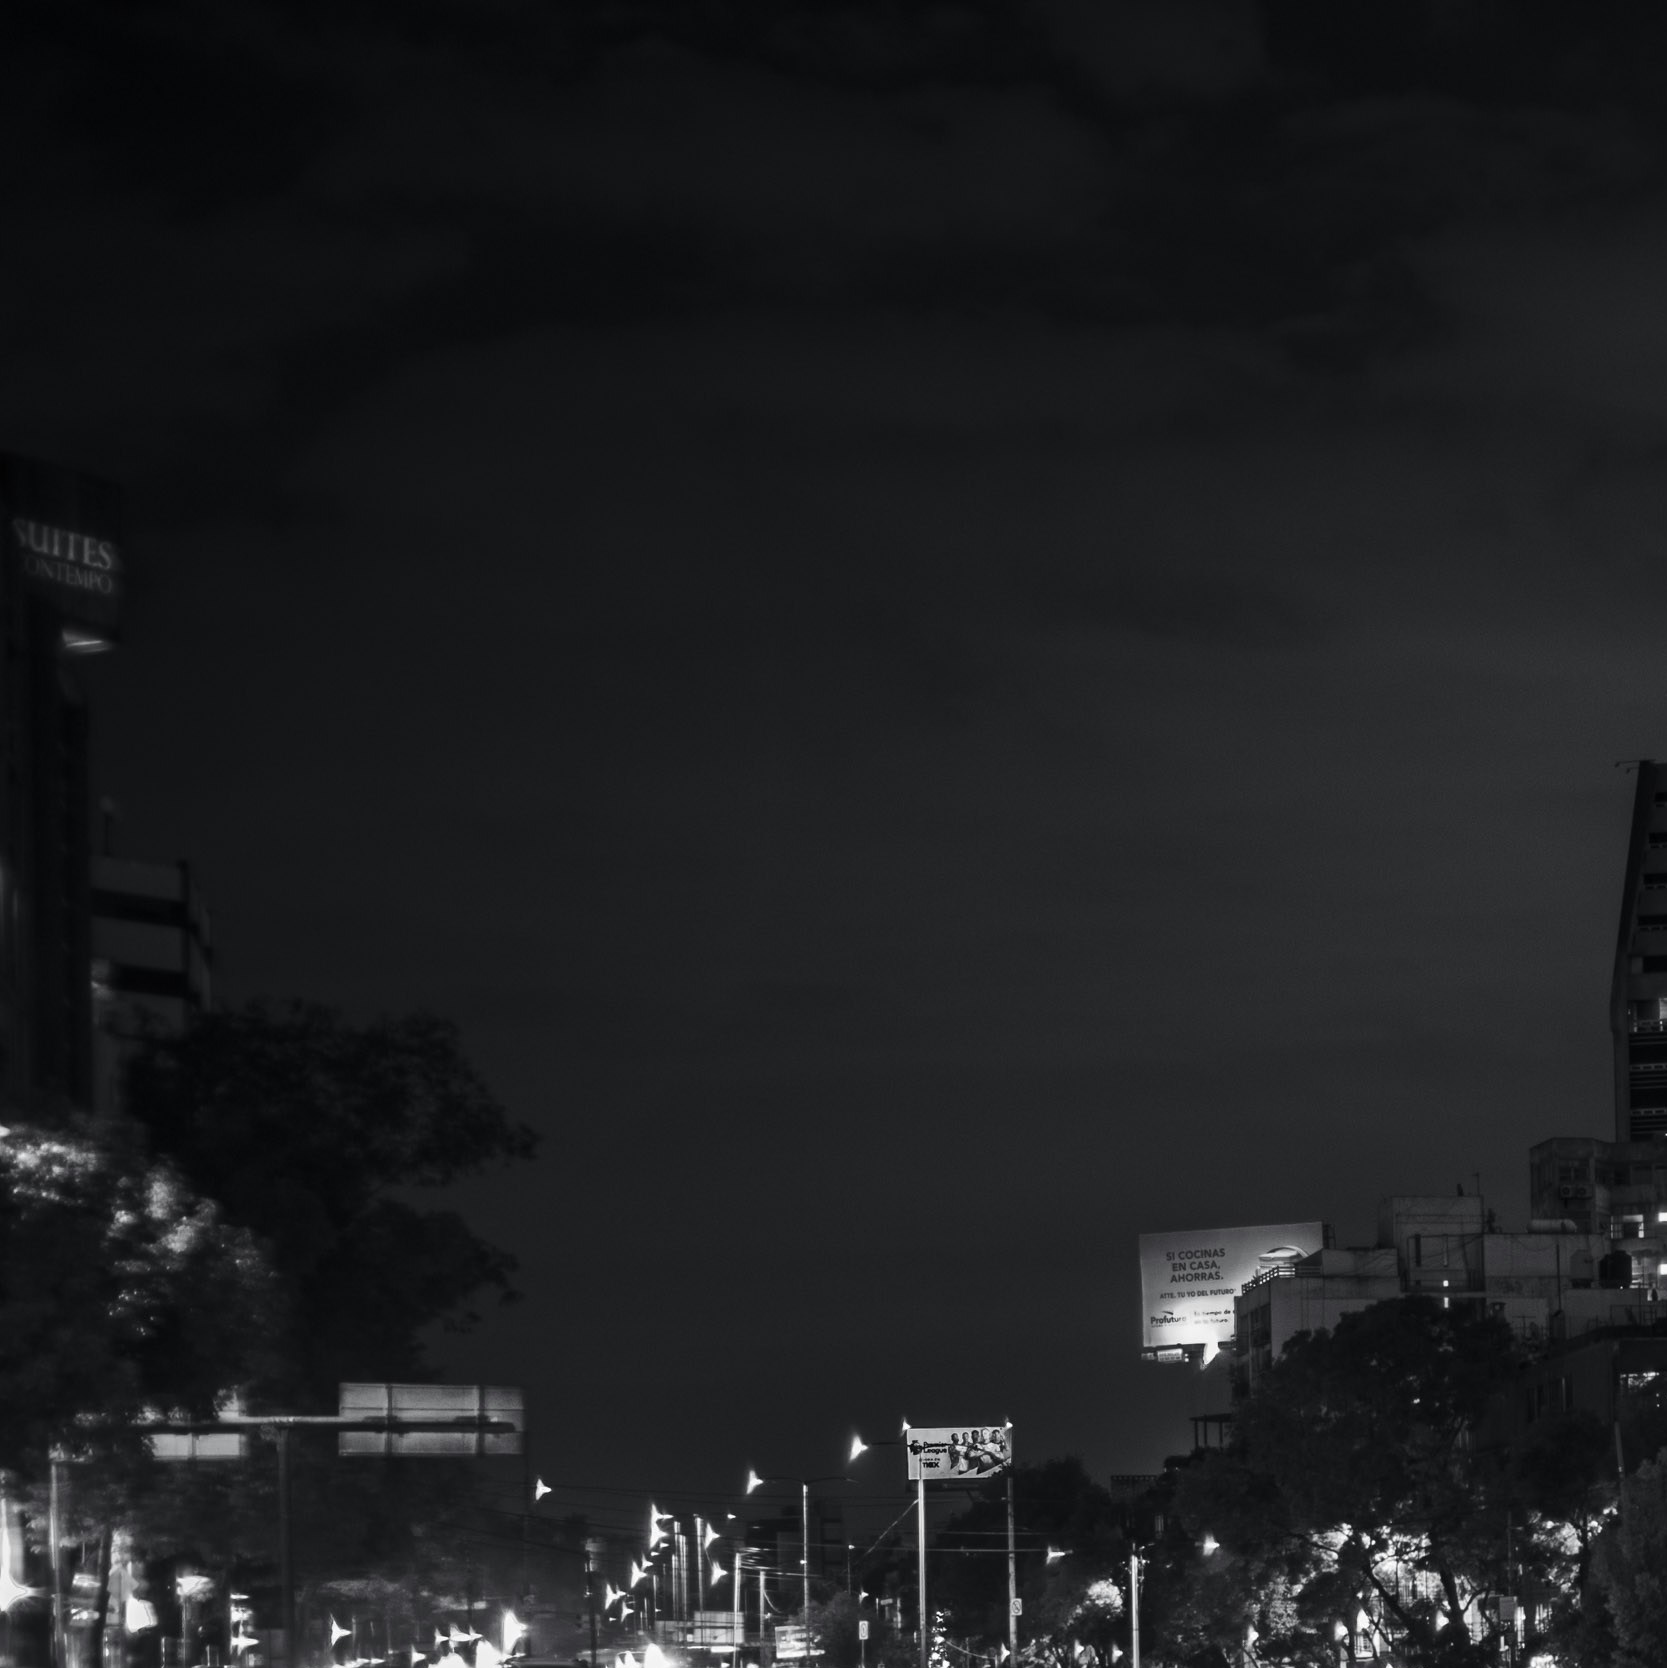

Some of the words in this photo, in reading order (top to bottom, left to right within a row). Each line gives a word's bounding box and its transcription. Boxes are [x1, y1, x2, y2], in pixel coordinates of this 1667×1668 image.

[12, 518, 113, 570] SUITES
[24, 557, 113, 594] ONTEMPO
[1166, 1251, 1176, 1261] SI
[1178, 1248, 1226, 1260] COCINAS
[1172, 1262, 1186, 1272] EN
[1190, 1260, 1221, 1271] CASA,
[1170, 1272, 1224, 1284] AHORRAS.
